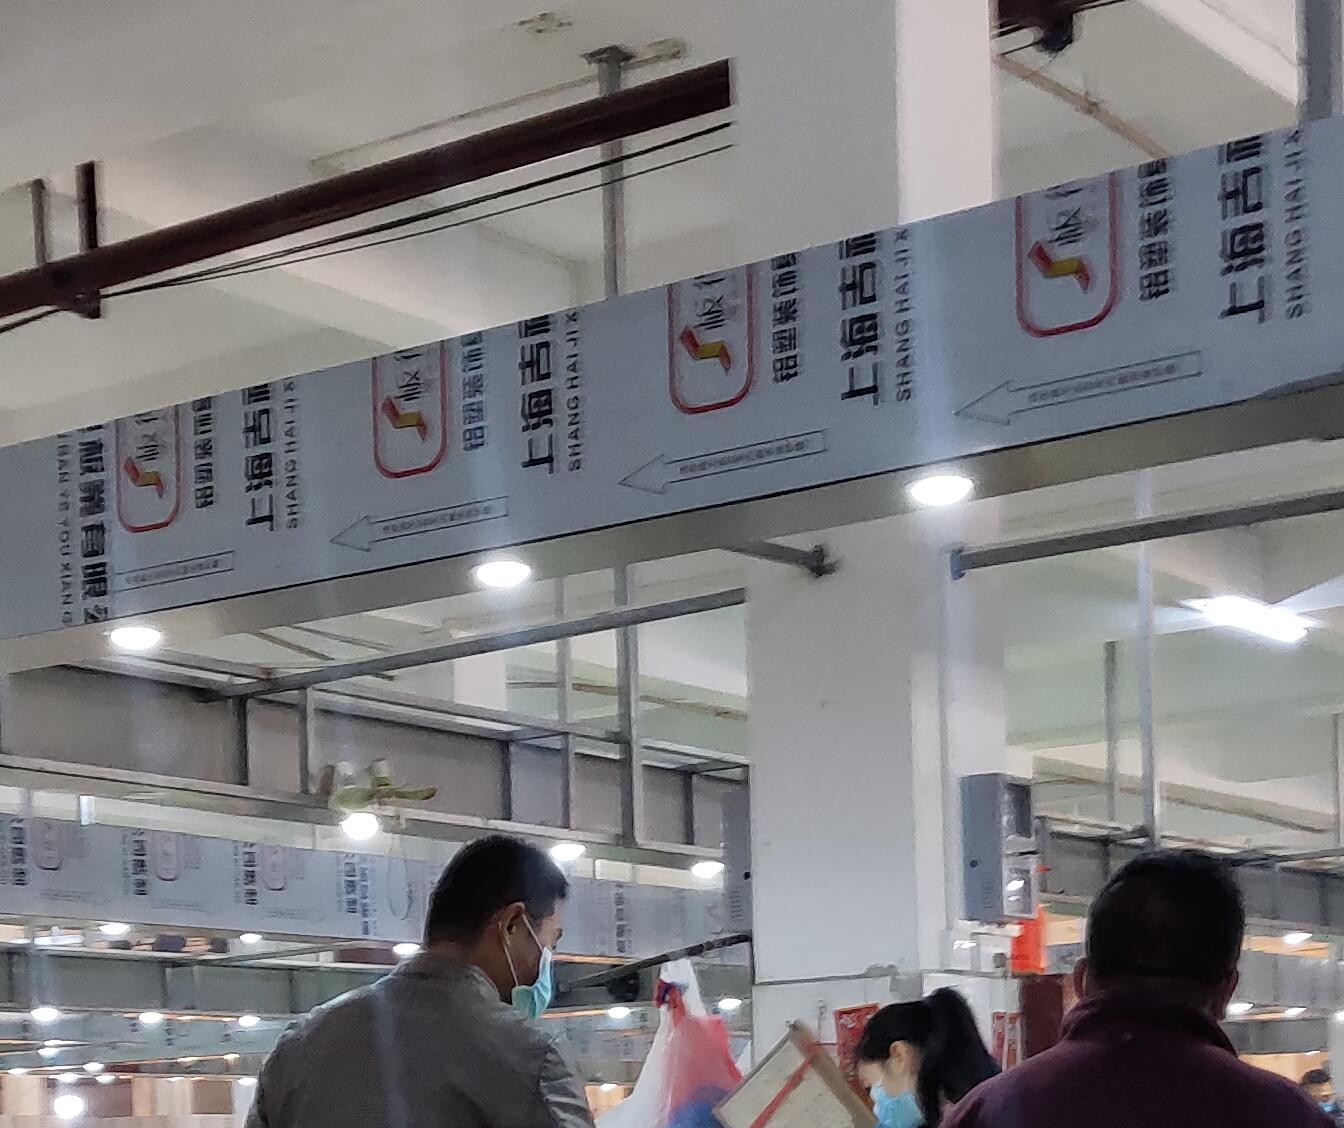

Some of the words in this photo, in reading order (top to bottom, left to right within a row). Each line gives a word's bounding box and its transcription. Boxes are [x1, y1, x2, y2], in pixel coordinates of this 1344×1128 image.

[1283, 179, 1306, 223] HAI
[894, 273, 913, 313] HAI
[1283, 230, 1306, 320] SHANG
[565, 353, 583, 390] HAI
[894, 319, 913, 402] SHANG
[565, 395, 583, 472] SHANG
